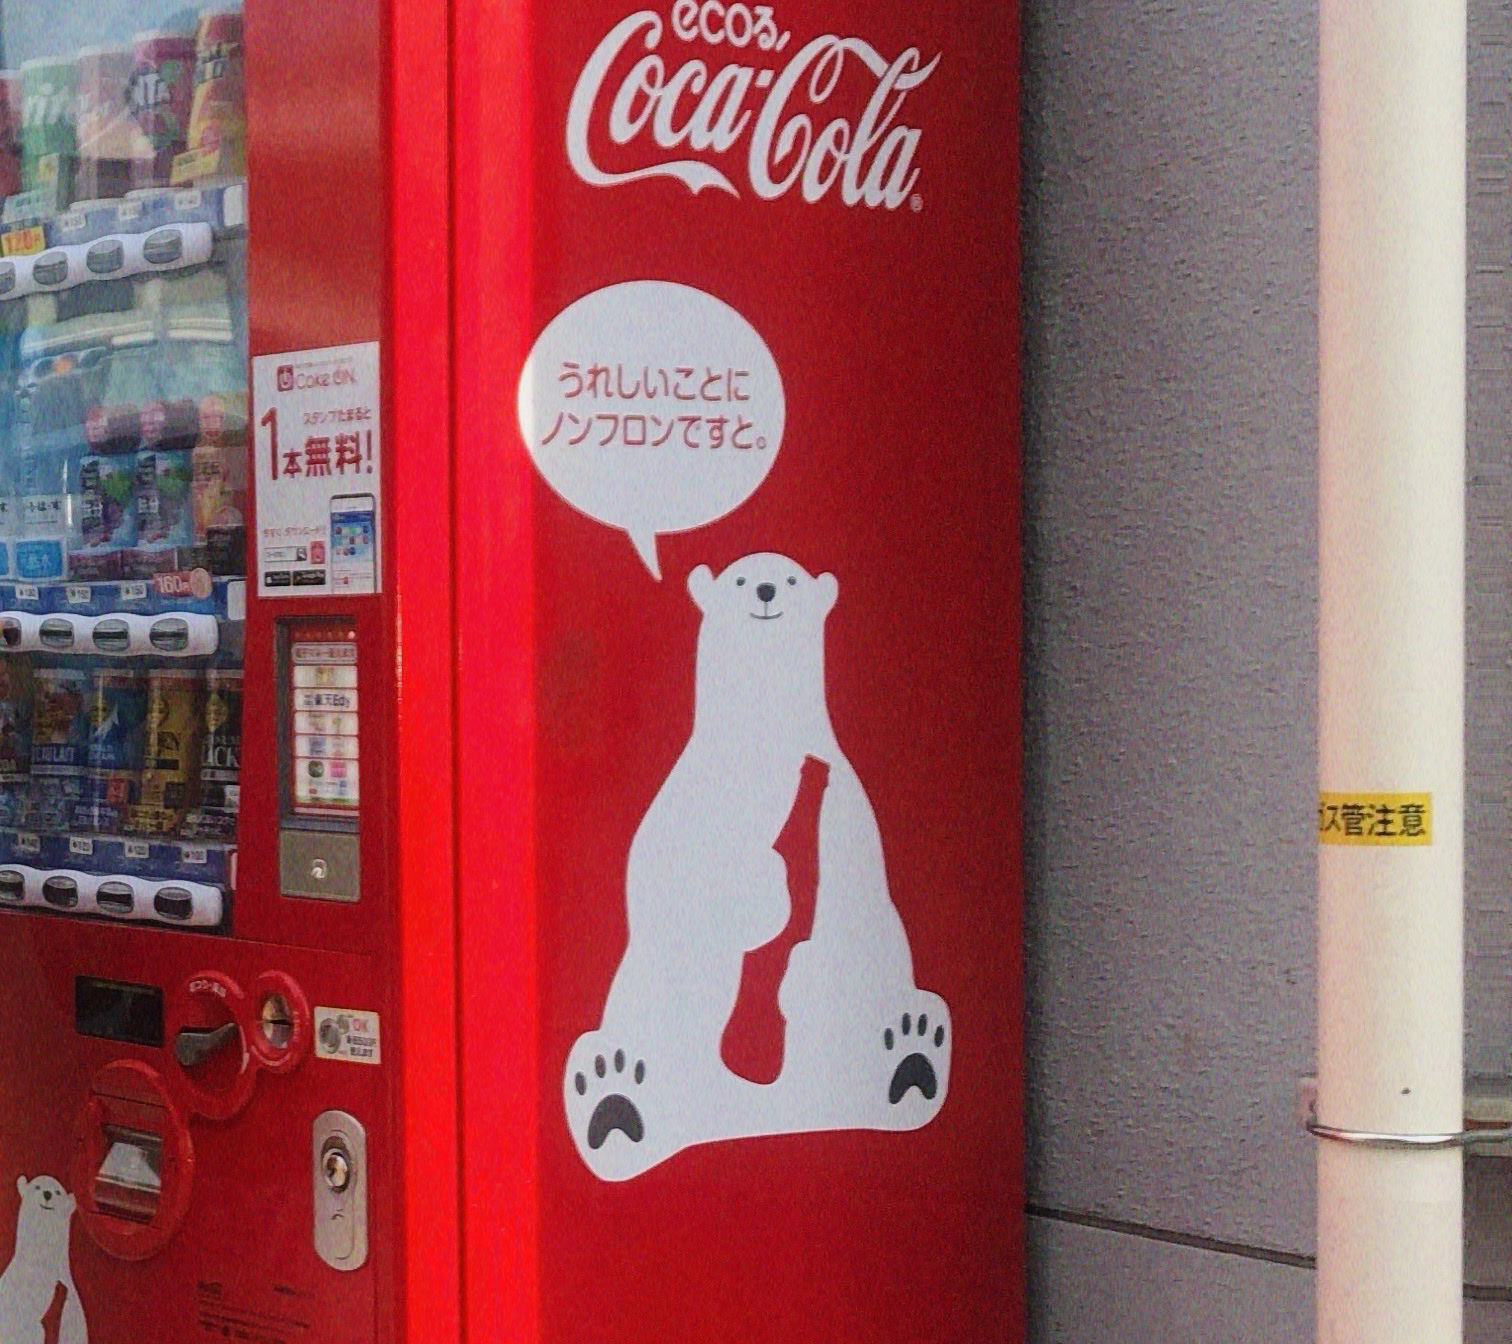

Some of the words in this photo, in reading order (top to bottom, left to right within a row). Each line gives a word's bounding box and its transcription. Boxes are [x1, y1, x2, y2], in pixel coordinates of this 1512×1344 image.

[565, 9, 942, 213] Coca-Cola
[557, 359, 751, 402] うれしいことに
[540, 413, 768, 451] ノンフロンですと。
